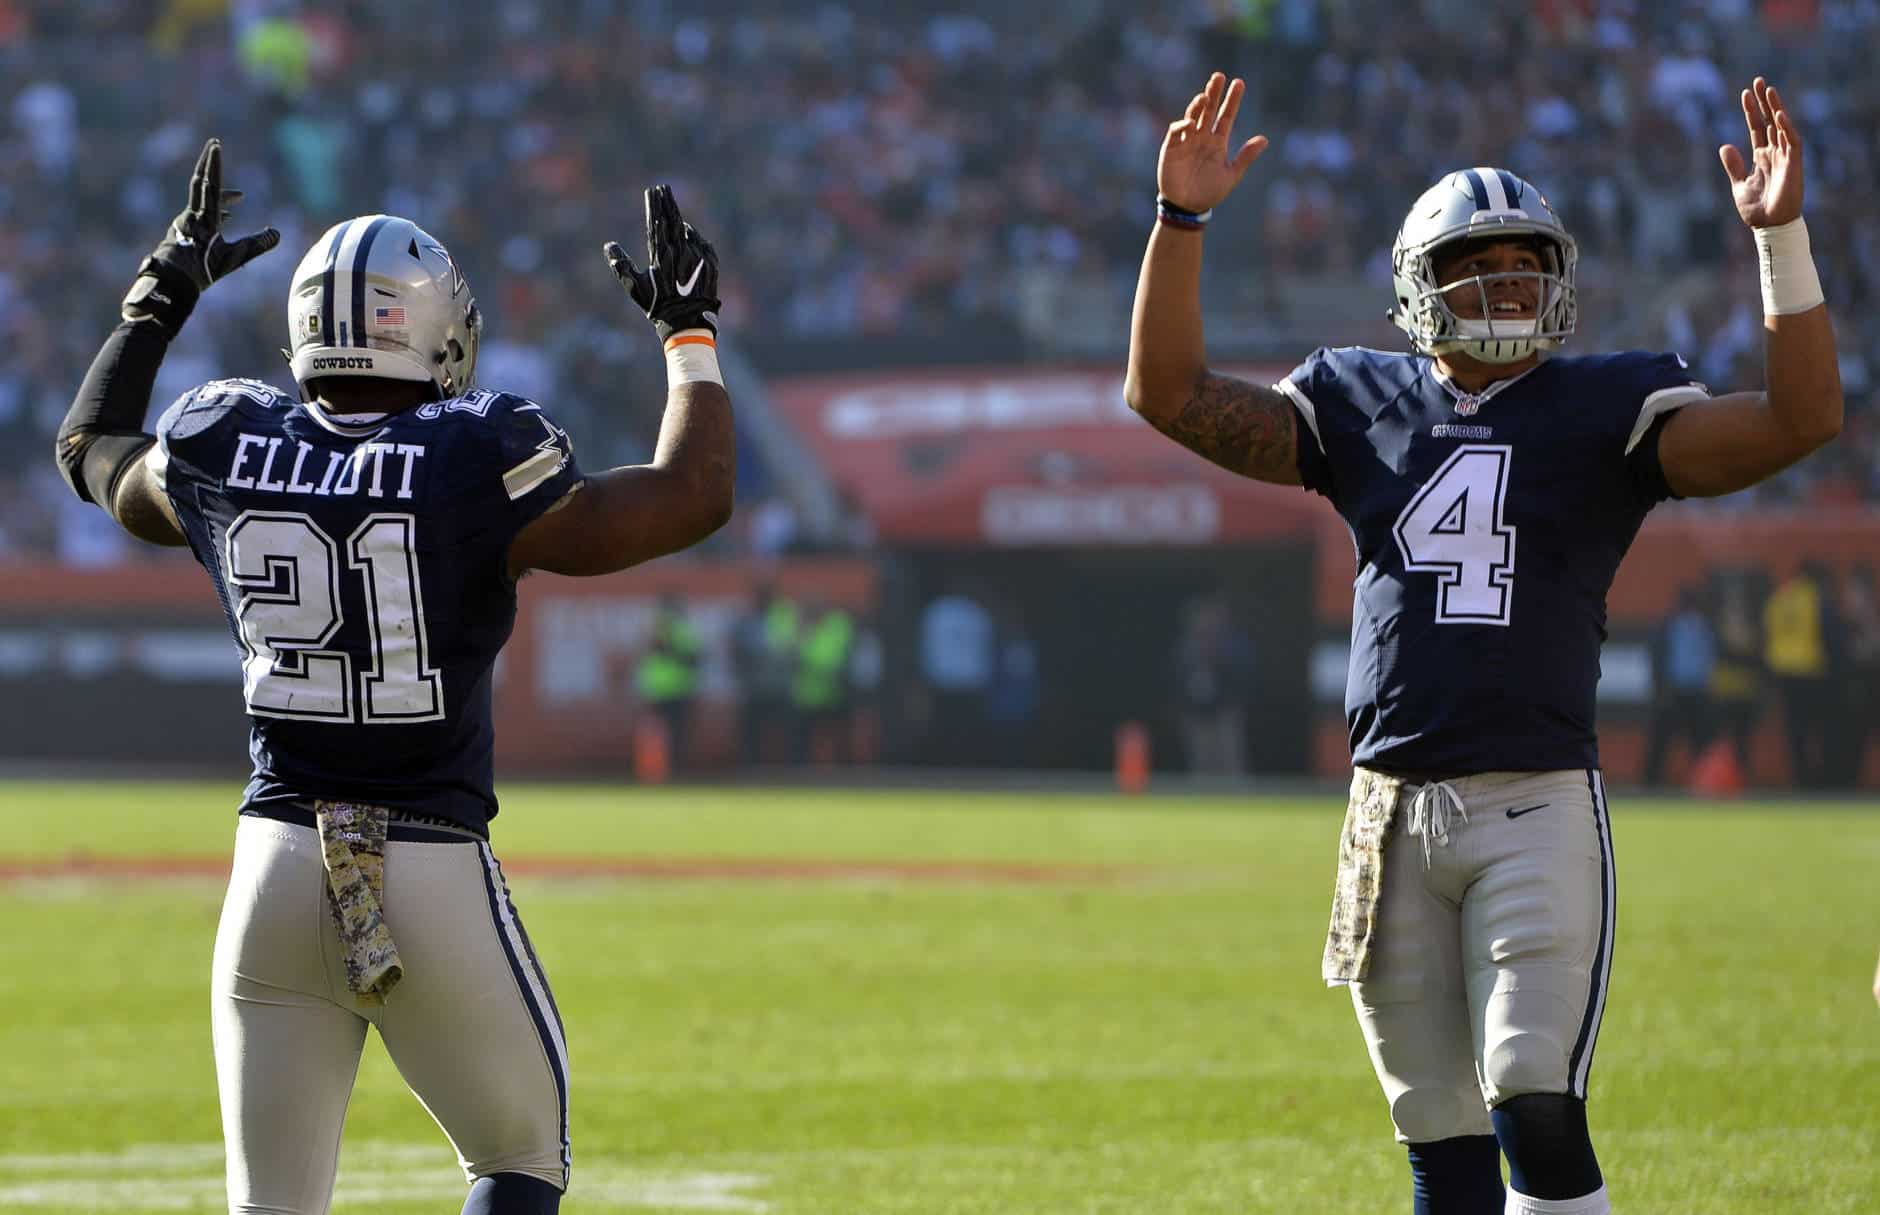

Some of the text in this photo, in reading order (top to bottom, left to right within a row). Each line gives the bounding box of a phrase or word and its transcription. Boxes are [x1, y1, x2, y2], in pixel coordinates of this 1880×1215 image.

[313, 357, 373, 369] COWBOYS
[226, 433, 425, 499] ELLIOTT
[1392, 444, 1517, 627] 4
[225, 509, 447, 725] 21
